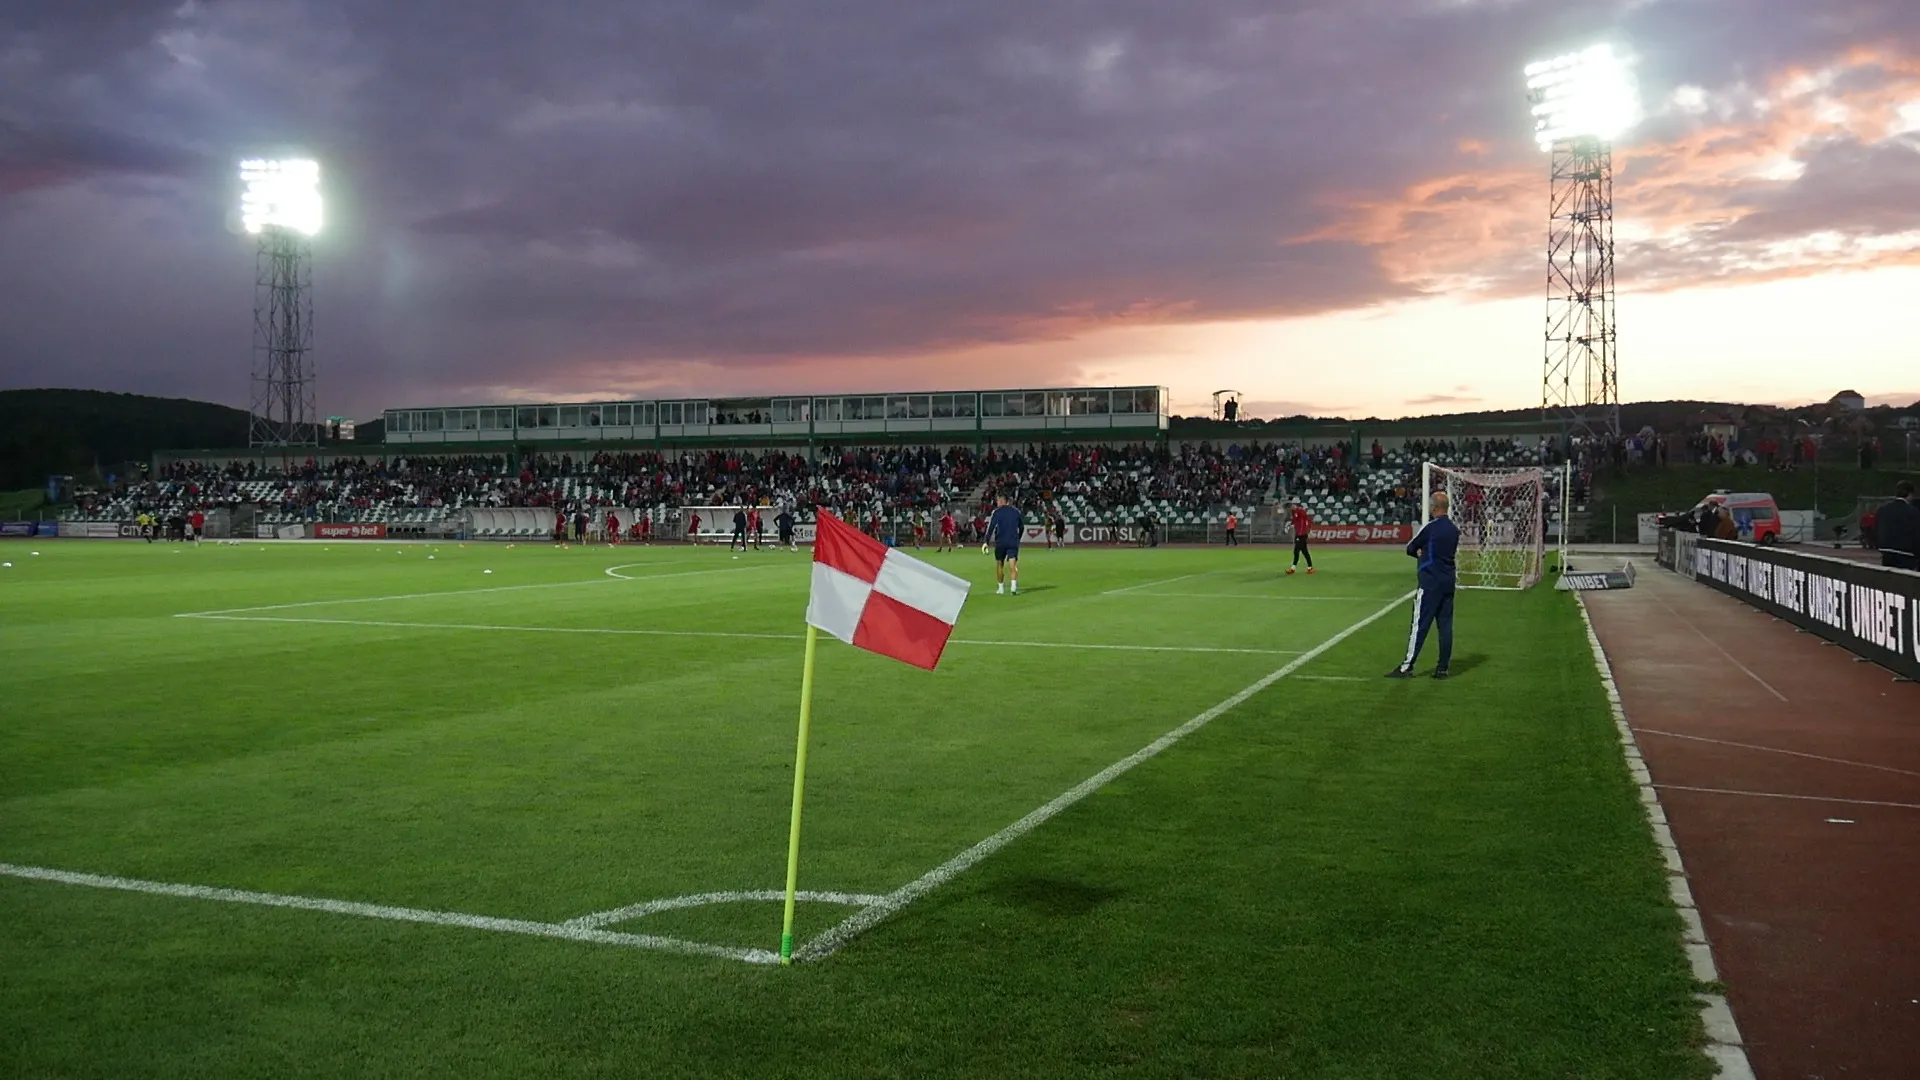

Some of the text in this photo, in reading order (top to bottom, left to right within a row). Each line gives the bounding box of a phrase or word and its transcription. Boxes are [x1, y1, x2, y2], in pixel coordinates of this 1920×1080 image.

[121, 525, 142, 536] CITY
[320, 525, 378, 536] super bet
[1079, 527, 1113, 541] CITY
[1307, 527, 1400, 541] super bet
[1564, 574, 1609, 589] UNIBET
[1773, 564, 1805, 614] UNIBET
[1808, 572, 1847, 631] UNIBET
[1850, 583, 1906, 655] UNIBET
